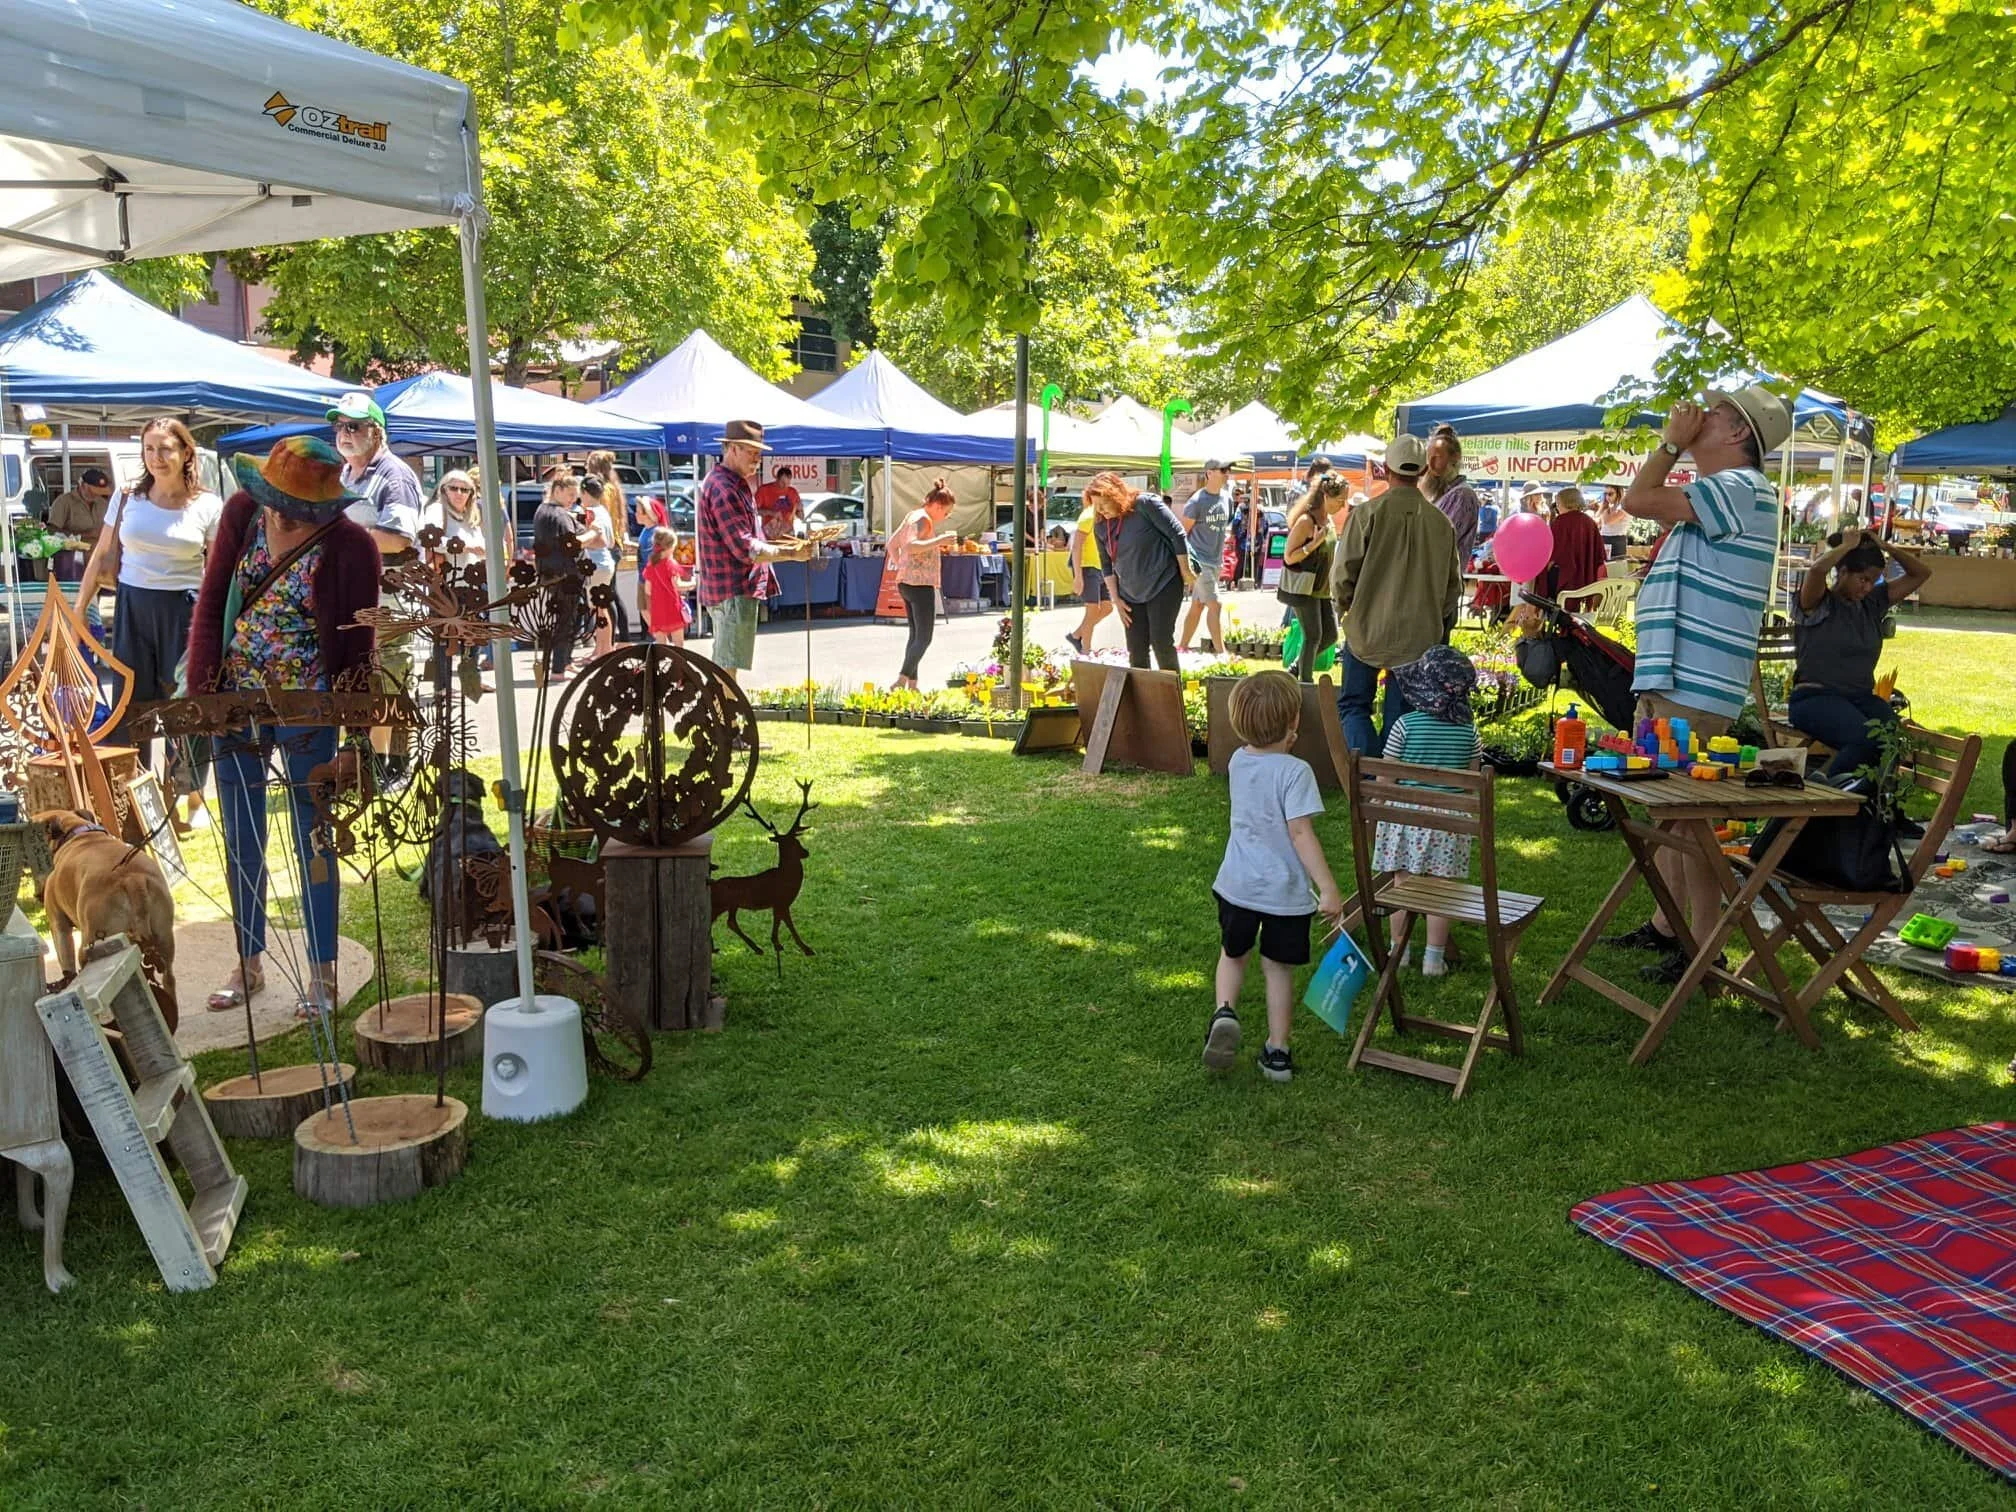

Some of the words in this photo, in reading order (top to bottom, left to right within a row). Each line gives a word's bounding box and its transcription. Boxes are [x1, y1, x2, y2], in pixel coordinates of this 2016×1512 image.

[287, 123, 340, 142] Commercial
[342, 134, 371, 149] Deluxe
[373, 142, 386, 152] 3.0
[301, 106, 387, 142] OZtrail
[1505, 437, 1530, 451] hills
